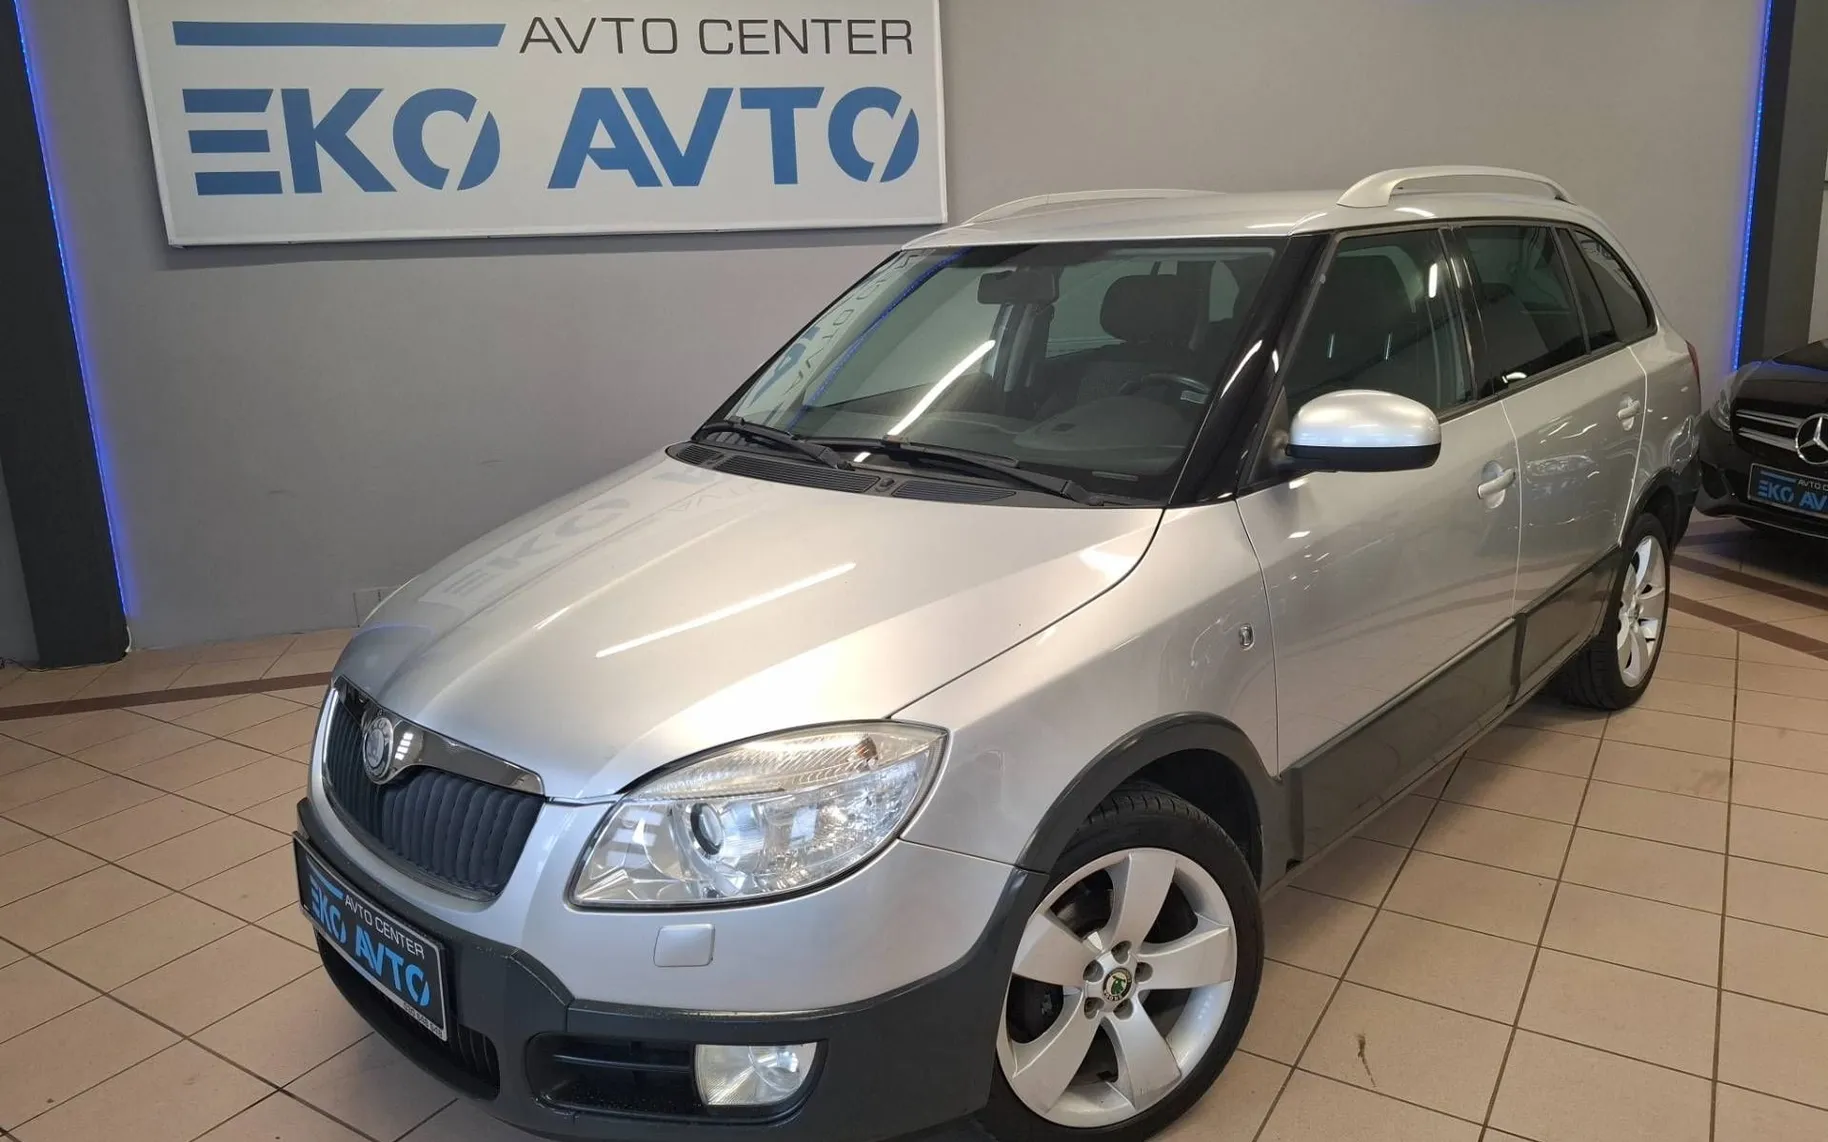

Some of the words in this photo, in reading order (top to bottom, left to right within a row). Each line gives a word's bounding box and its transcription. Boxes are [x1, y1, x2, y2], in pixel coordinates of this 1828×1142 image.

[520, 17, 677, 54] AVTO
[699, 18, 913, 55] CENTER
[182, 88, 500, 195] EKO
[548, 86, 920, 189] AVTO
[1758, 480, 1794, 503] EKO
[310, 874, 347, 944] EKO
[355, 924, 430, 1007] AVTO
[345, 895, 372, 926] AVTO
[375, 916, 425, 960] CENTER
